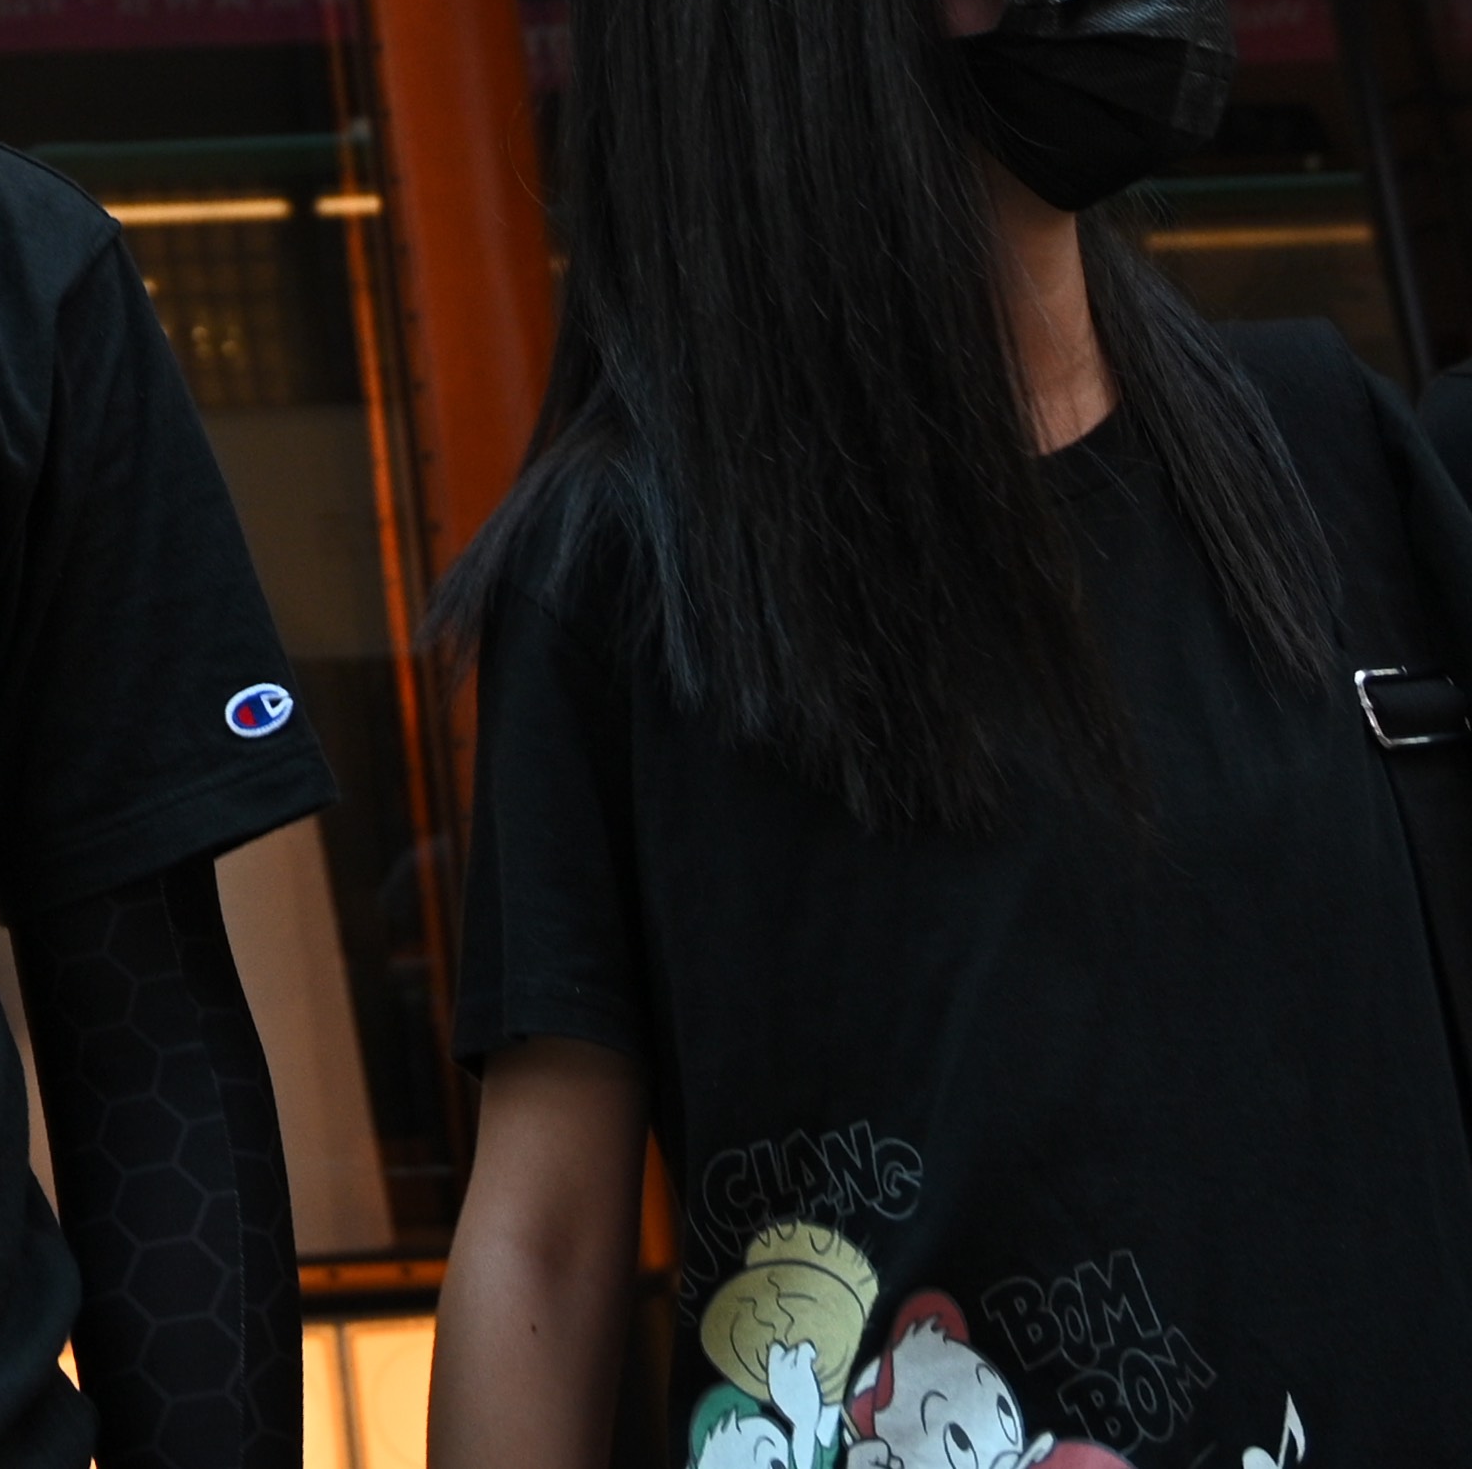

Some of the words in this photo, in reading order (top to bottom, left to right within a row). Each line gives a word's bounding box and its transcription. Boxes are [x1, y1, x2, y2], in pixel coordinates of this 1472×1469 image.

[703, 1119, 924, 1232] CLANG
[980, 1248, 1162, 1371] BOM
[1057, 1324, 1218, 1456] BOM
